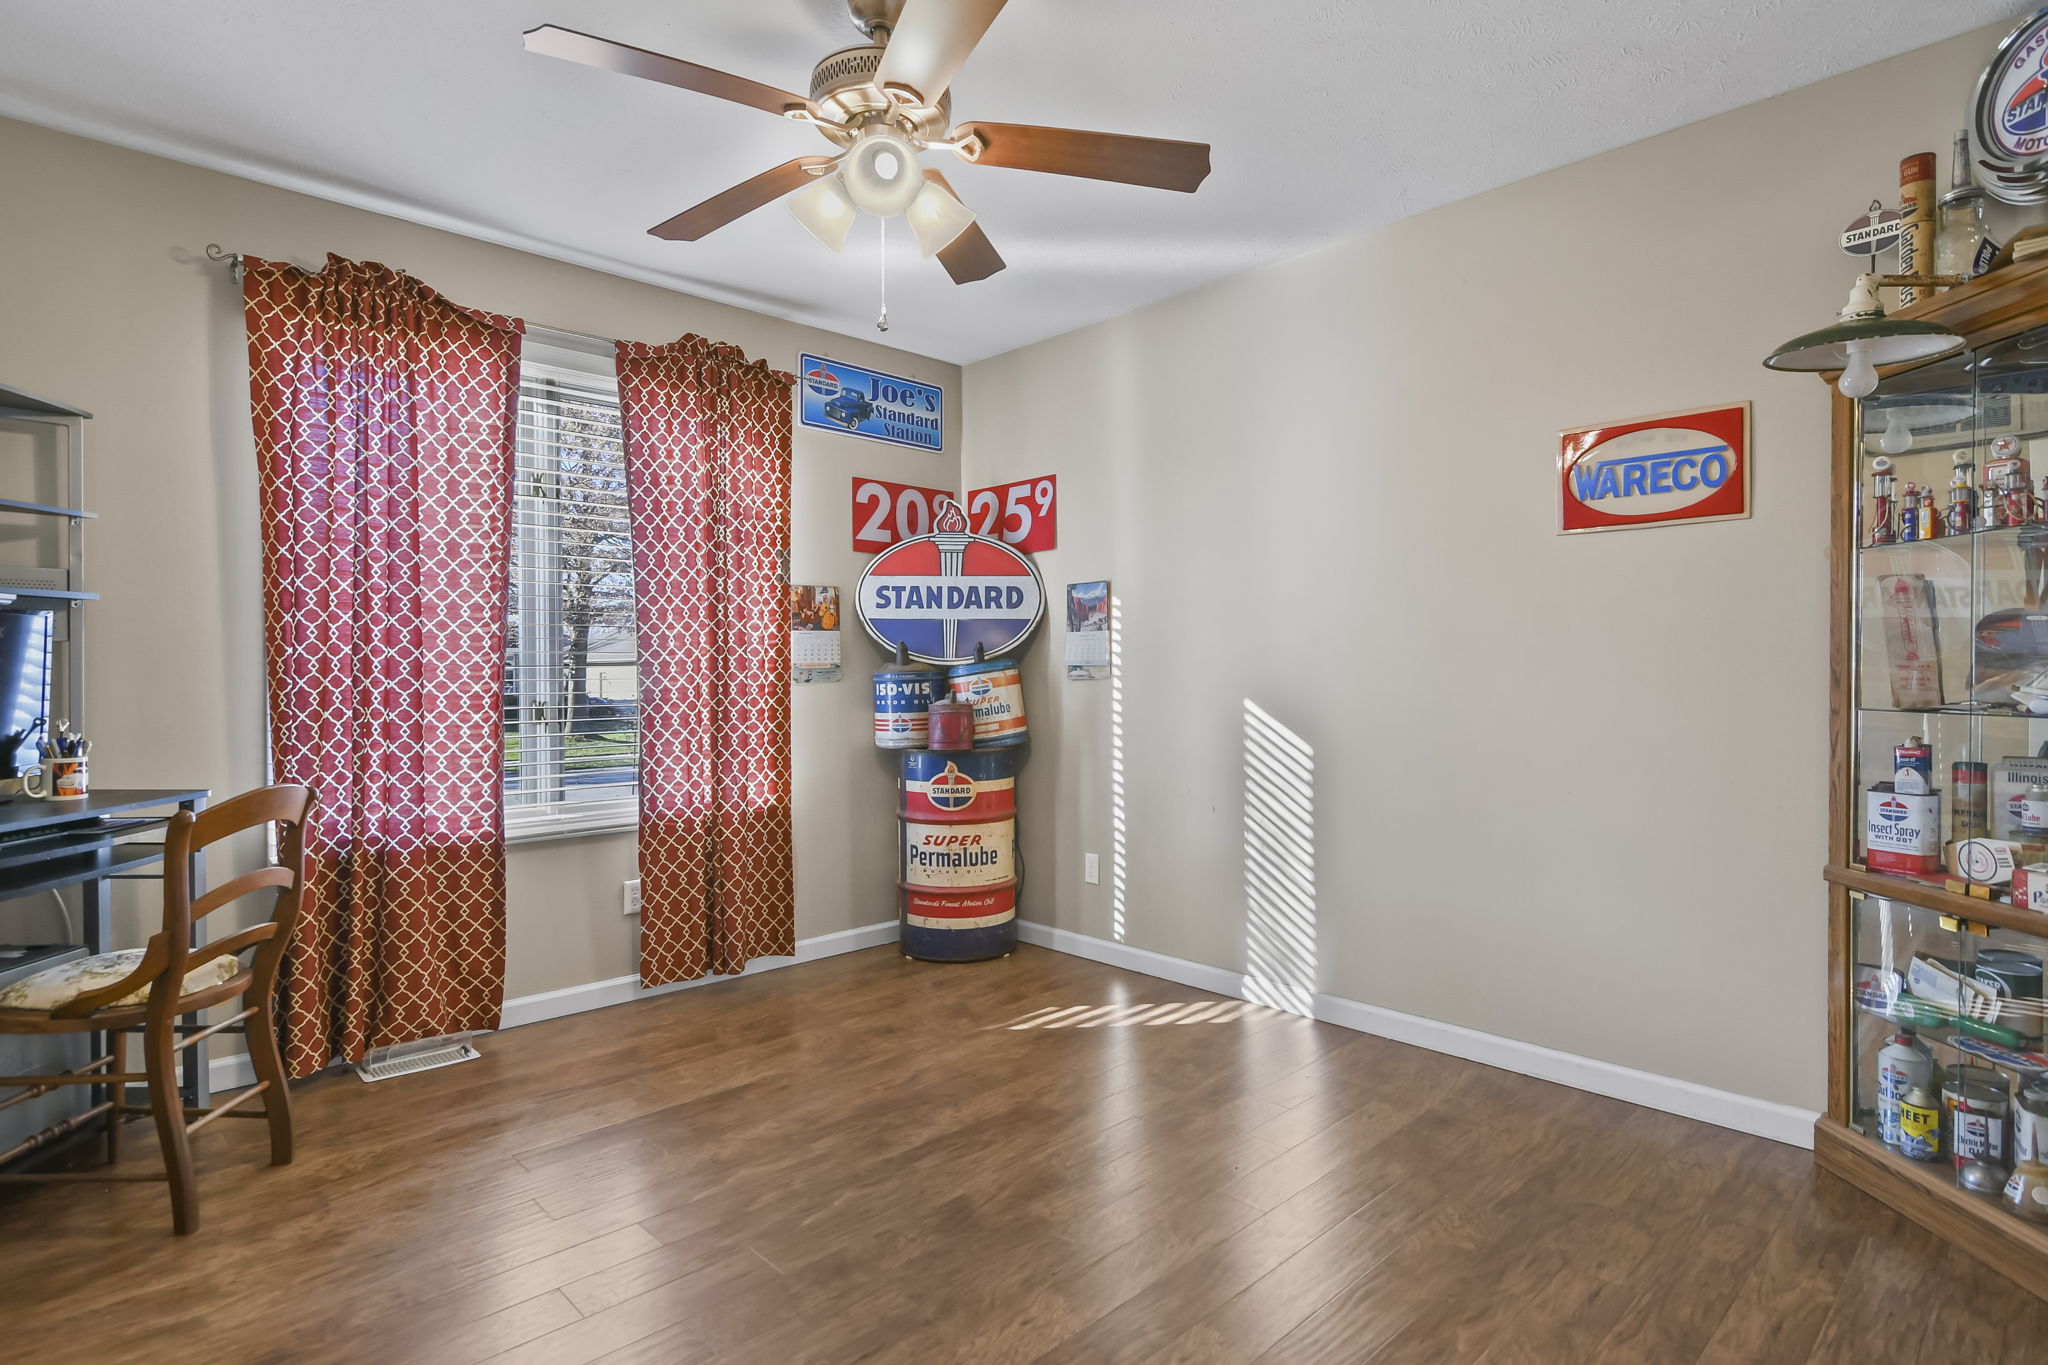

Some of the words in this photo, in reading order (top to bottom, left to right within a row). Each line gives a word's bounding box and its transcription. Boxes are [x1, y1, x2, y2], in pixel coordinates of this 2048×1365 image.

[2014, 30, 2048, 70] GAS
[1845, 222, 1900, 244] STANDARD
[808, 377, 839, 390] STANDARD
[868, 377, 937, 413] Joe's
[875, 404, 939, 431] Standard
[883, 422, 932, 446] Station
[1573, 450, 1728, 502] WARECO
[875, 585, 1024, 610] STANDARD
[876, 682, 931, 696] ISO-VIS
[932, 786, 971, 795] STANDARD
[1868, 819, 1892, 835] Insect
[1894, 822, 1921, 839] Spray
[1874, 833, 1894, 841] WITH
[922, 834, 982, 847] SUPER
[910, 844, 998, 868] Permalube
[961, 899, 982, 908] Motor
[983, 896, 996, 906] Oil
